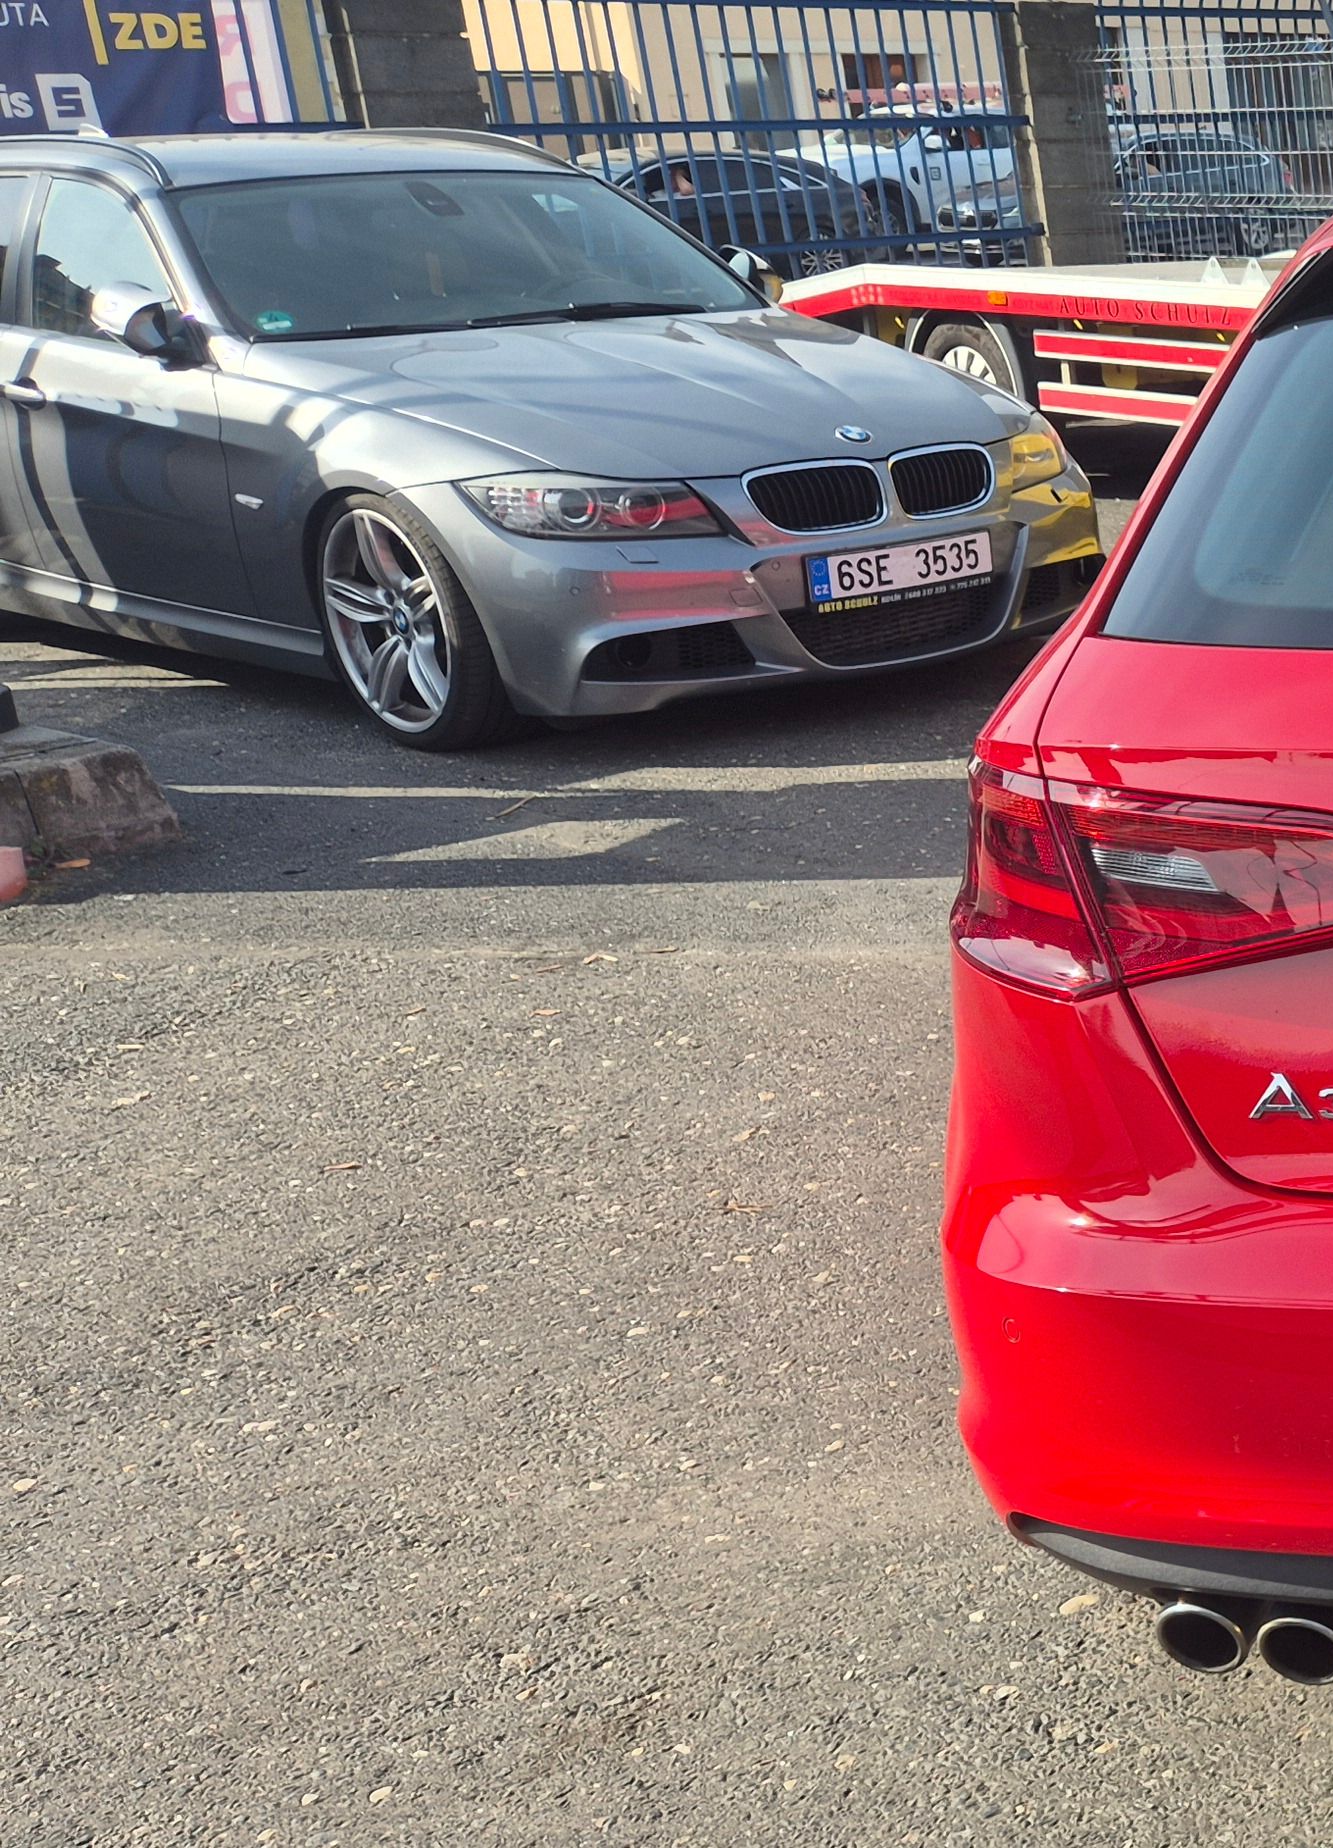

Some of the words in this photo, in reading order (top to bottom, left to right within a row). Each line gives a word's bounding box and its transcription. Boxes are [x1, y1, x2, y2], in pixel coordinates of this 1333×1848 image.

[108, 12, 206, 50] ZDE
[1060, 296, 1120, 318] AUTO
[814, 584, 830, 596] CZ
[837, 553, 893, 592] 6SE
[915, 538, 979, 579] 3535
[818, 599, 843, 613] AUTO
